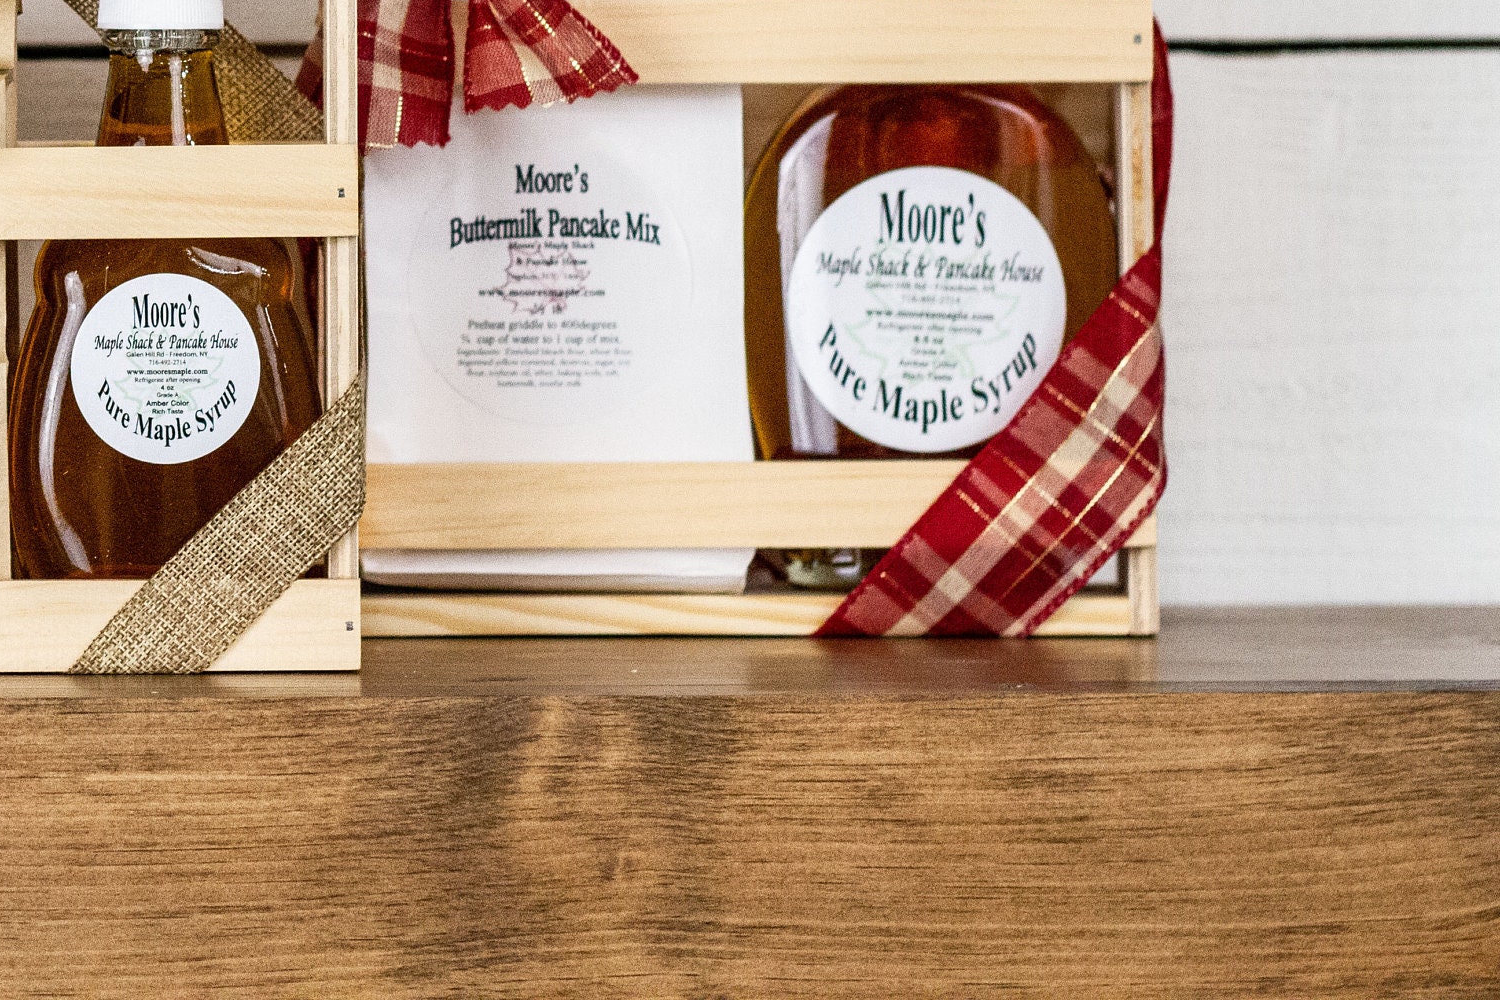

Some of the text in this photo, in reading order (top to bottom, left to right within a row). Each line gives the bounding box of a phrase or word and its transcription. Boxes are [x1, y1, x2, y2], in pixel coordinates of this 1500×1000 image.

[515, 163, 589, 194] Moore's
[450, 207, 661, 249] Buttermilk Pancake Mix
[877, 188, 986, 249] Moore's
[816, 247, 1045, 288] Maple Shack & Pancake House
[131, 293, 200, 329] Moore's
[94, 329, 239, 357] Maple Shack & Pancake House
[126, 367, 209, 376] www.mooresmaple.com
[819, 322, 1037, 434] Pure Maple Syrup
[97, 377, 238, 448] Pure Maple Syrup
